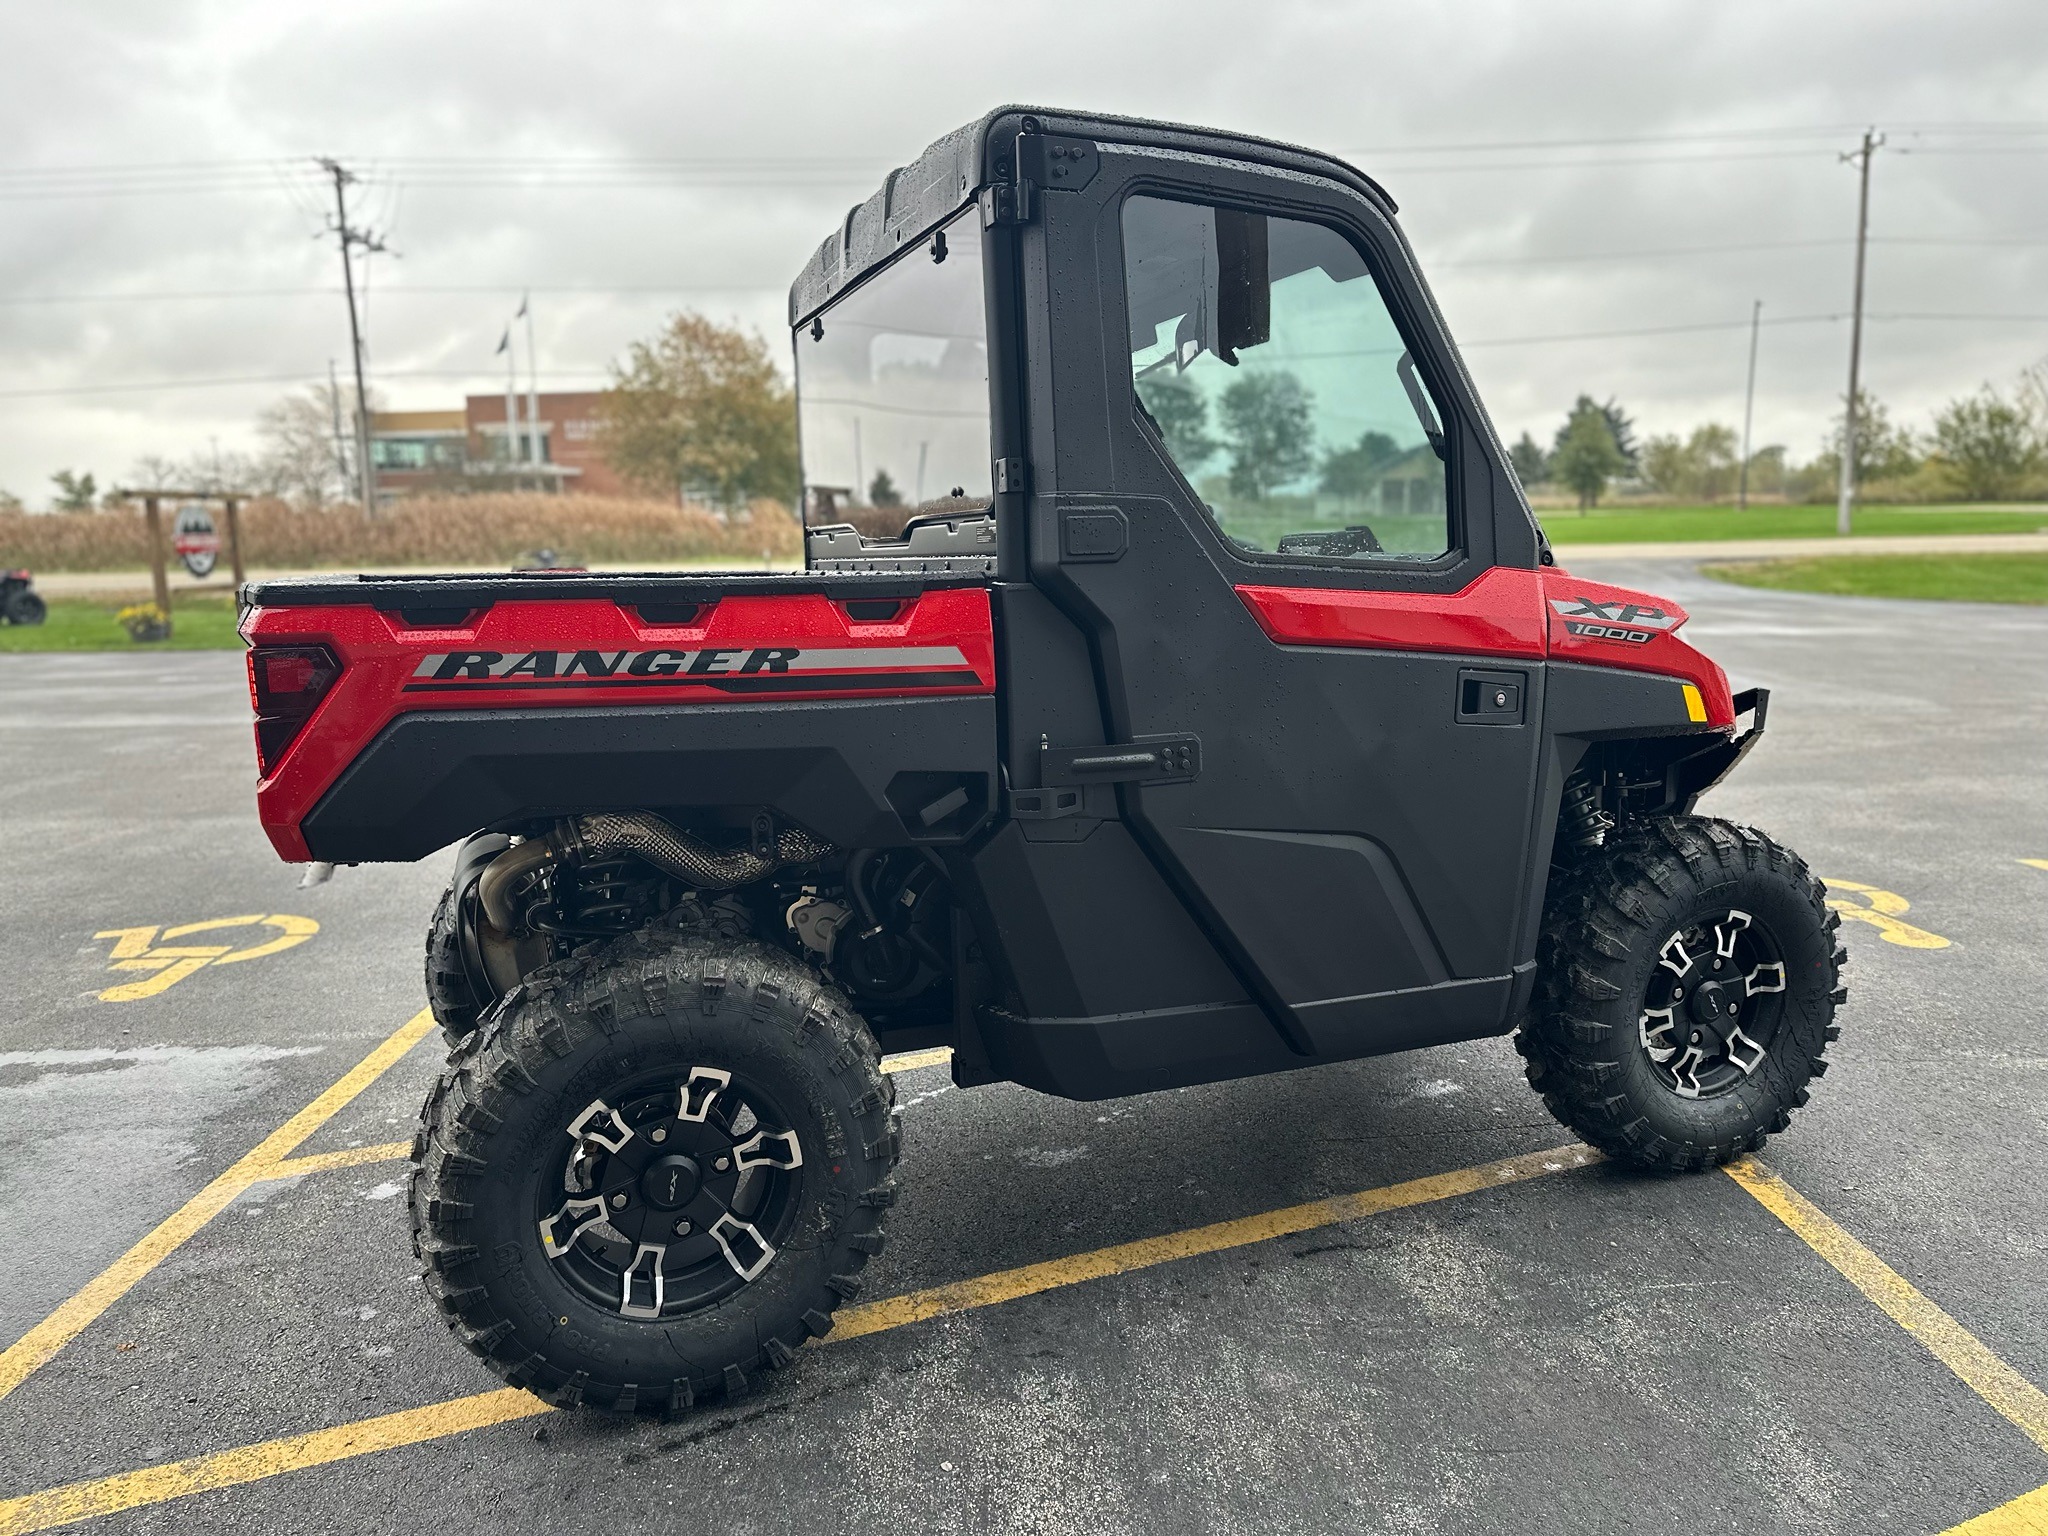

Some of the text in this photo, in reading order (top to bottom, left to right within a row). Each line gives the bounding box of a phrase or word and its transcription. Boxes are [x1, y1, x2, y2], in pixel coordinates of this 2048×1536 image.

[1563, 597, 1666, 623] XP
[1575, 624, 1648, 643] 1000
[431, 648, 800, 679] RANGER
